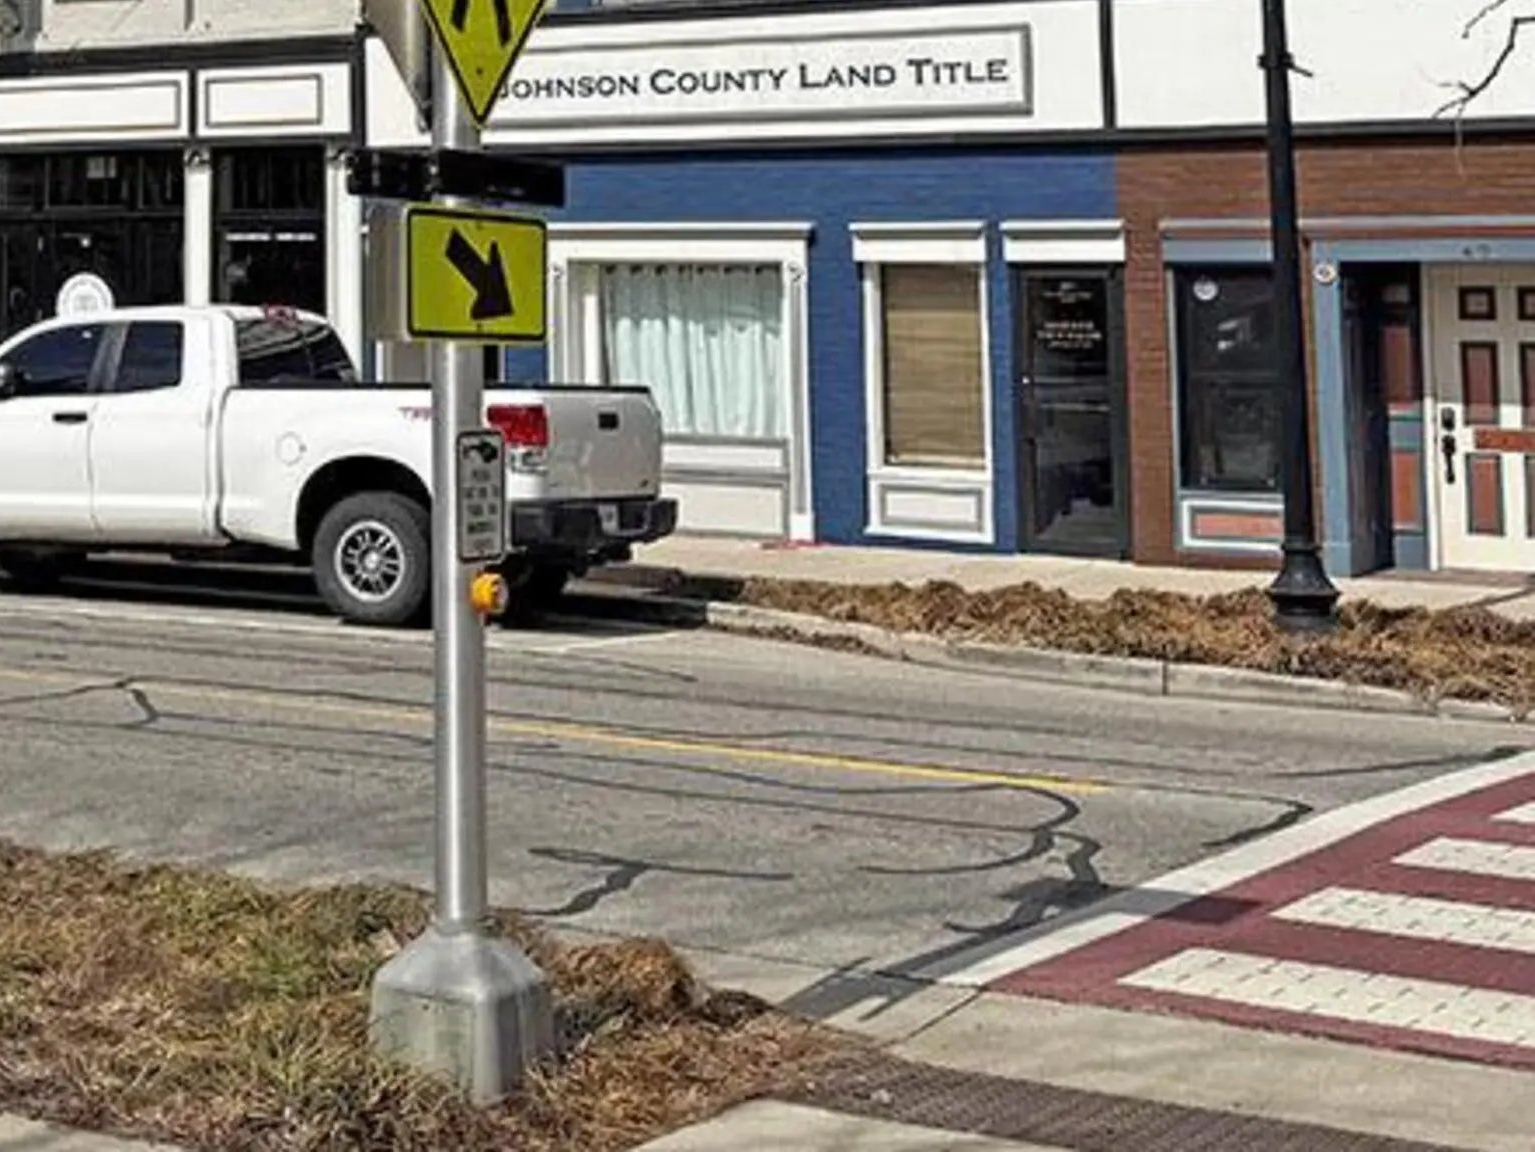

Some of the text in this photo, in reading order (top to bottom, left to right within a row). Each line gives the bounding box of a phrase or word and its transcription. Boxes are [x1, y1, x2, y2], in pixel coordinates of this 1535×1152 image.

[499, 57, 1010, 99] JOHNSON COUNTY LAND TITLE
